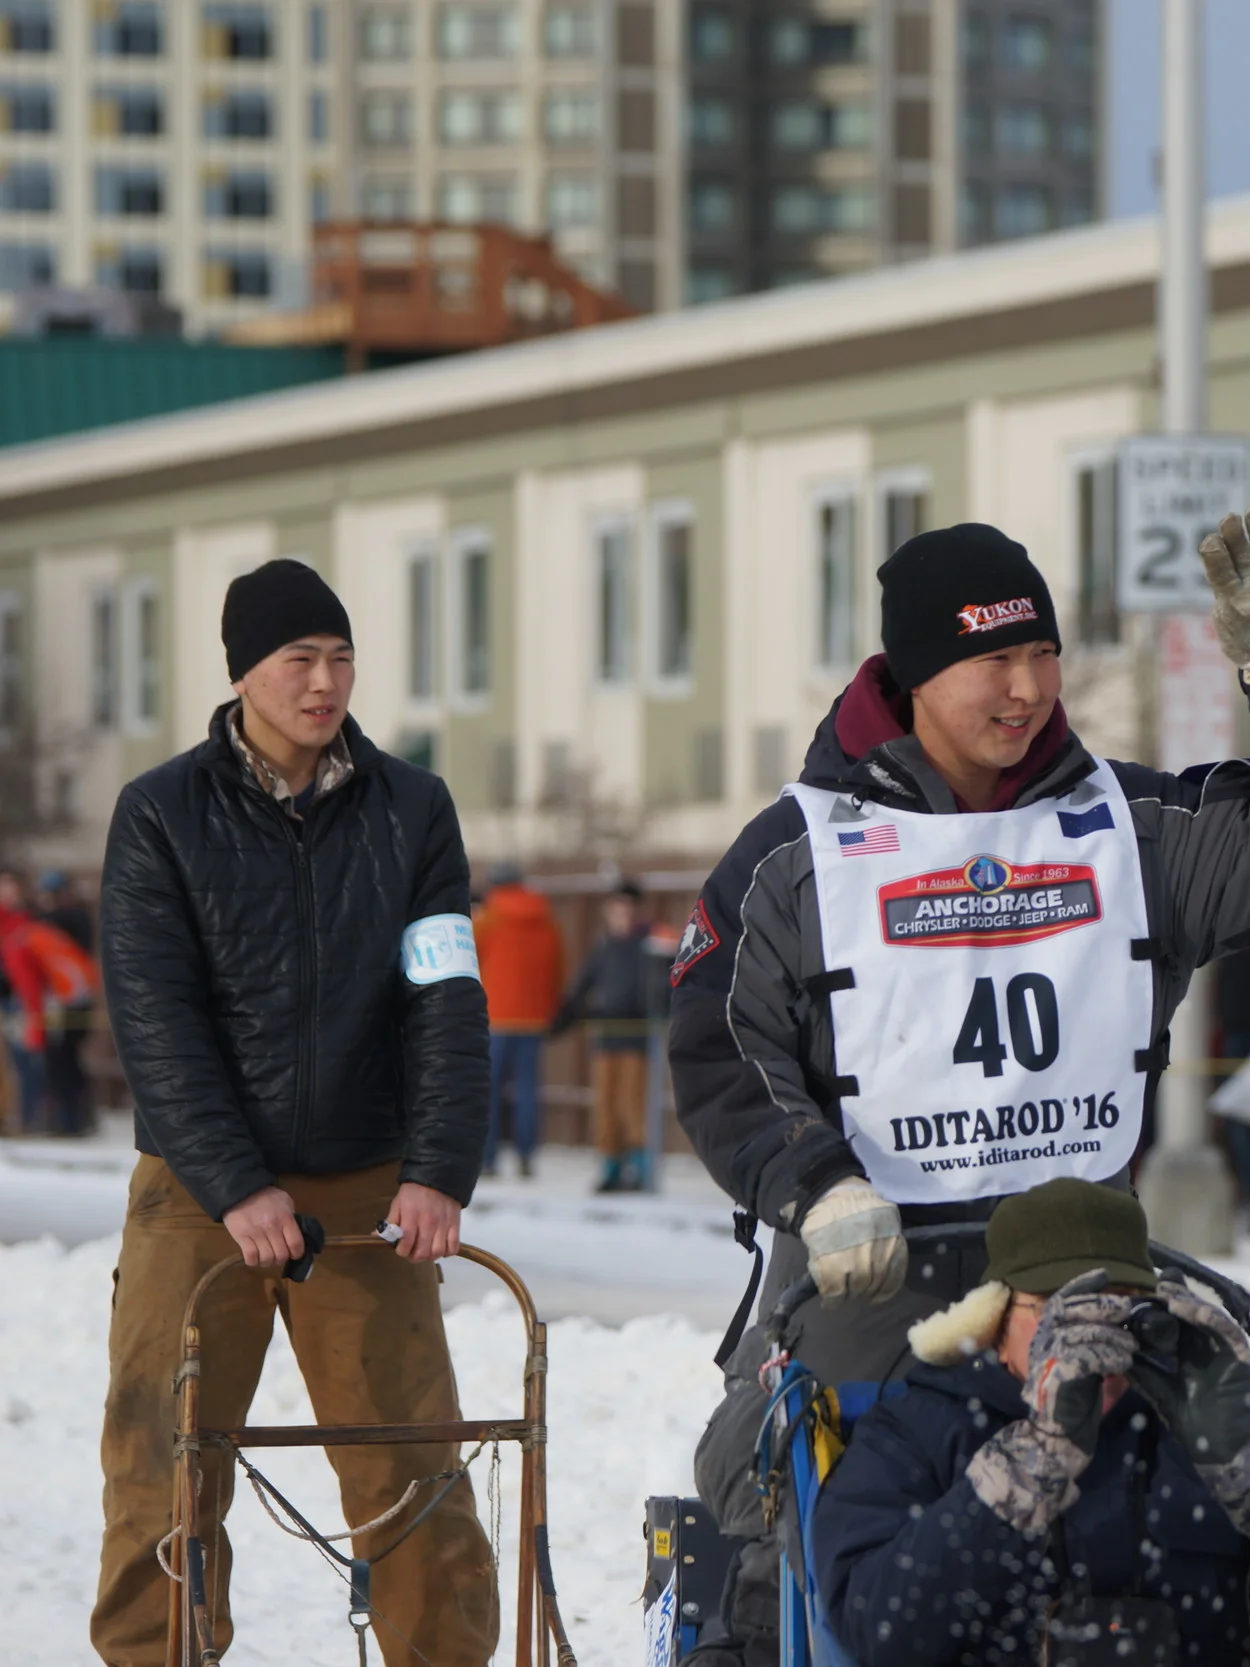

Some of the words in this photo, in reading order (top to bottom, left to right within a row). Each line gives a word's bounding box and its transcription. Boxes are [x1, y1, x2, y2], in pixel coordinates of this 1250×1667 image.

[916, 879, 927, 889] In
[929, 877, 964, 888] Alaska
[1013, 871, 1040, 883] Since
[1041, 867, 1069, 879] 1963
[894, 917, 961, 935] CHRYSLER
[969, 914, 1011, 928] DODGE
[1018, 911, 1048, 925] JEEP
[1056, 903, 1089, 918] RAM
[914, 889, 1064, 919] ANCHORAGE
[953, 972, 1060, 1078] 40
[890, 1098, 1065, 1151] IDITAROD
[1073, 1091, 1120, 1130] '16
[920, 1140, 1102, 1173] www.iditarod.com
